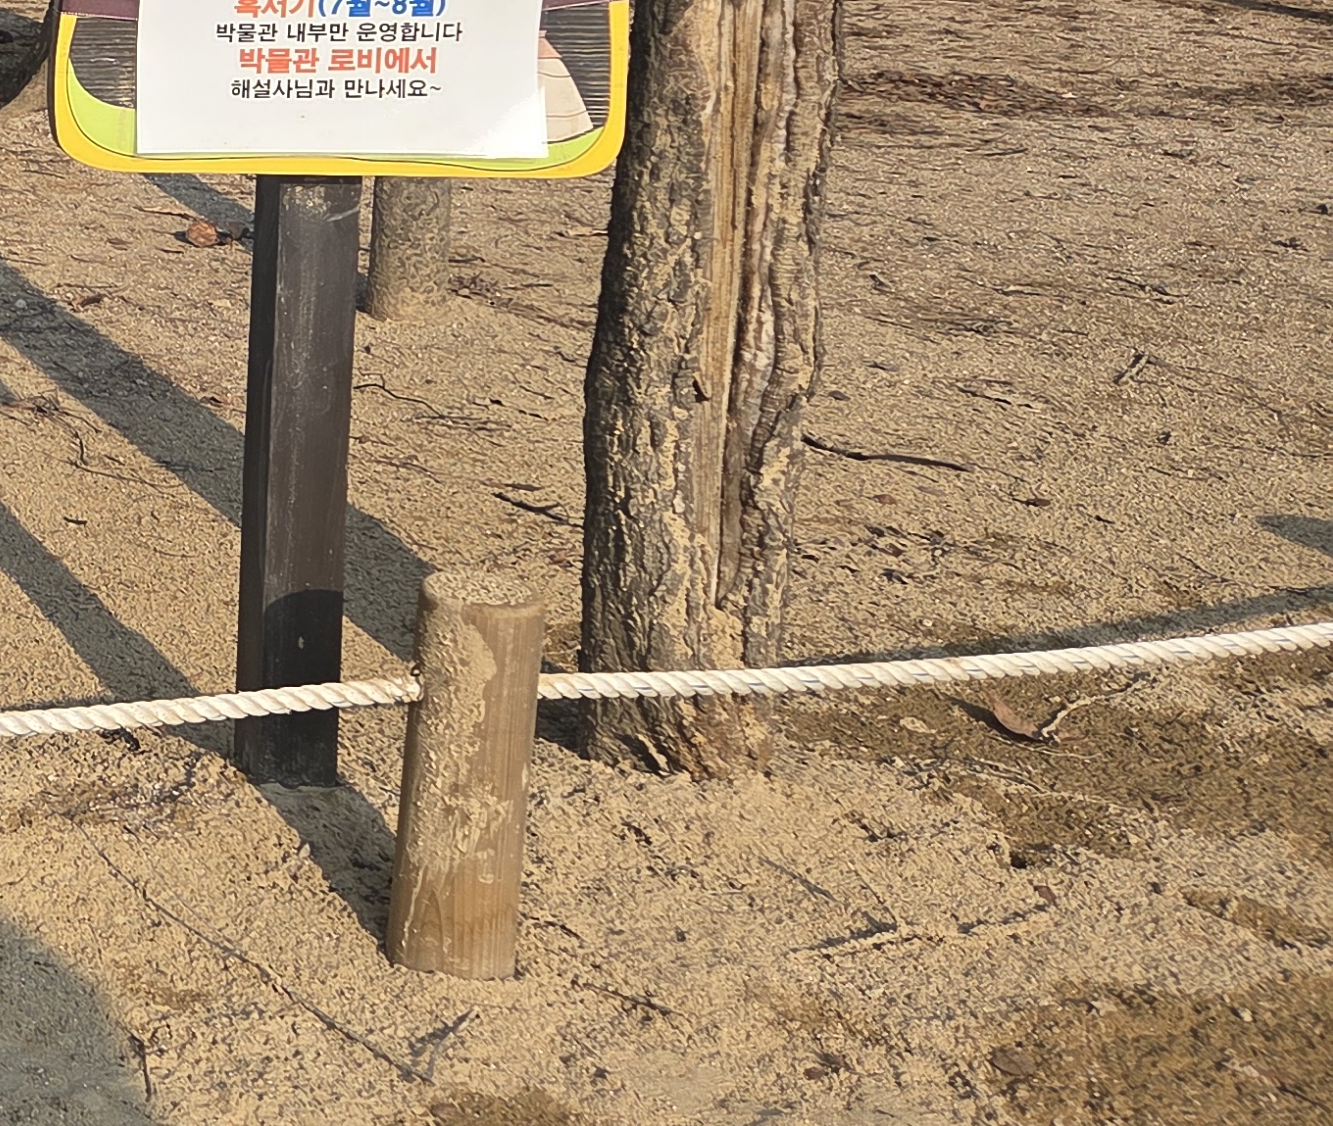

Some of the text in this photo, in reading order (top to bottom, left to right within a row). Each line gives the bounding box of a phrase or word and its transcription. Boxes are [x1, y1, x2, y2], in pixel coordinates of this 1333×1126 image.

[215, 22, 463, 43] 박물관 내부만 운영합니다
[238, 47, 437, 75] 박물관 로비에서
[231, 79, 442, 99] 해설사님과 만나세요~
